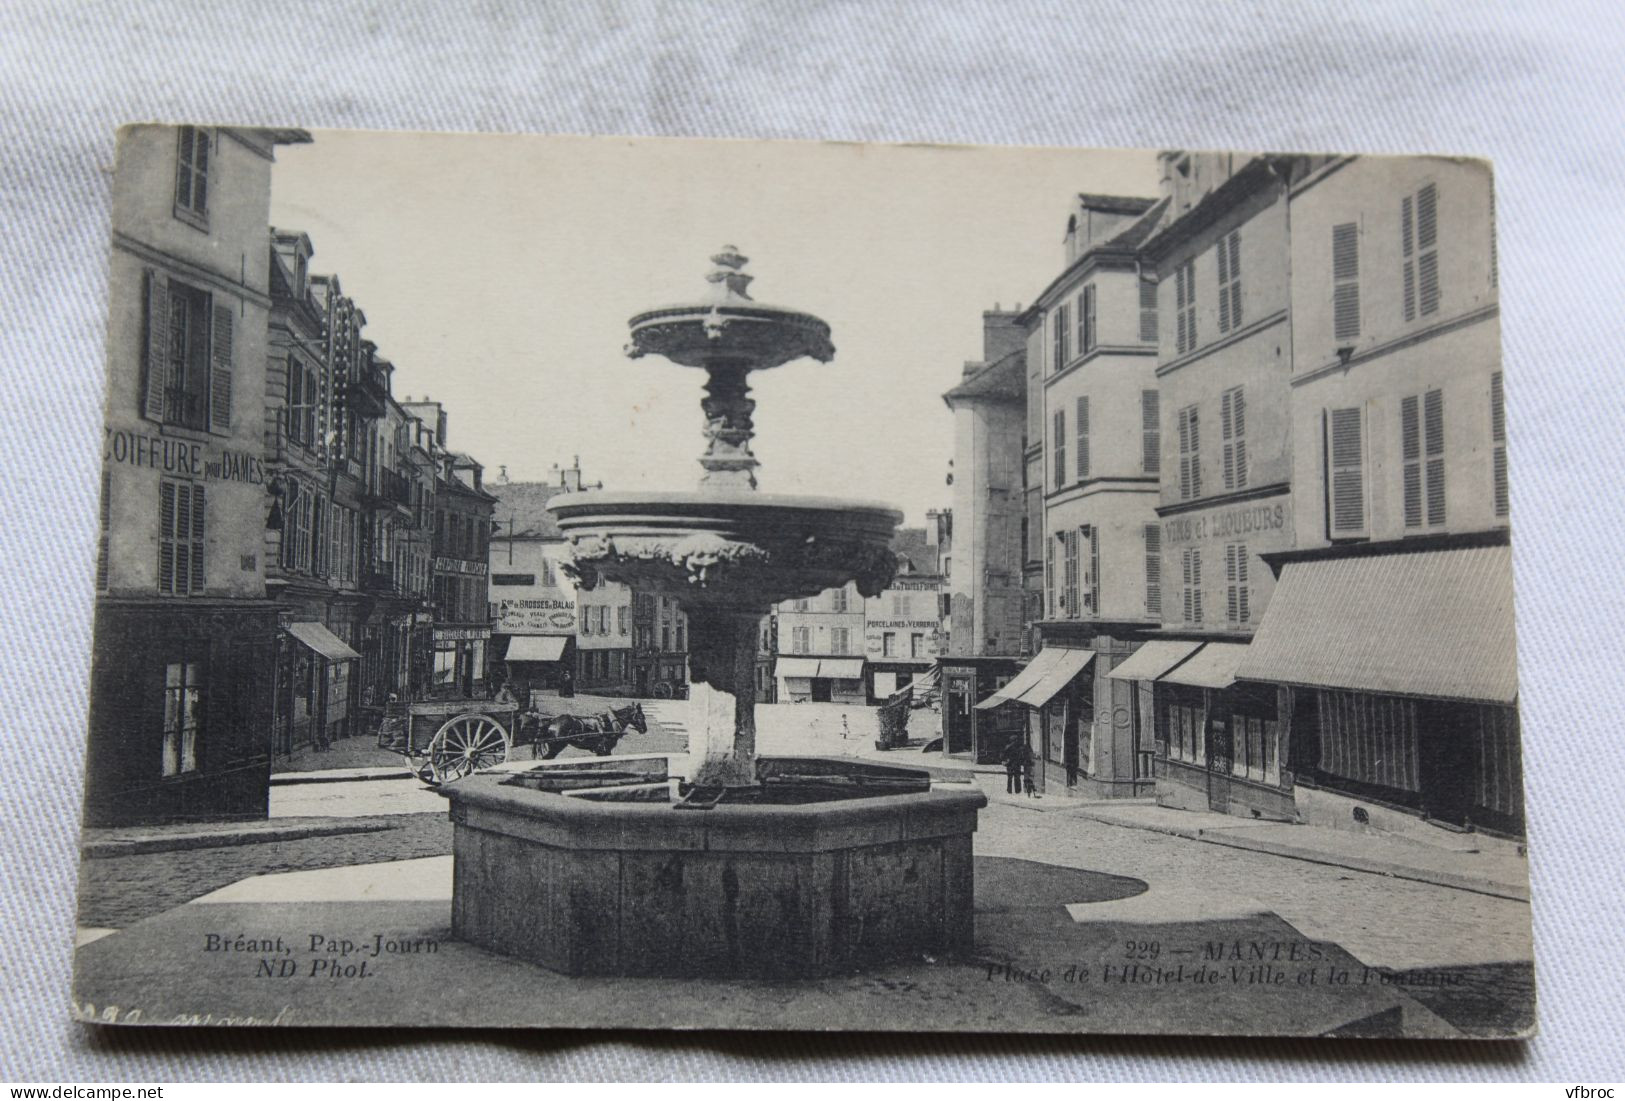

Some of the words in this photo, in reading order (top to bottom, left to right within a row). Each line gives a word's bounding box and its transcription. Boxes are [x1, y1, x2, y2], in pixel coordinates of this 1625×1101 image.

[222, 451, 264, 485] DAMES
[1212, 505, 1284, 537] LIQUEURS
[553, 600, 575, 609] BALAIS
[204, 934, 291, 955] Bréant,
[1125, 940, 1161, 960] 229
[1203, 942, 1330, 962] MANTES.
[256, 959, 296, 978] ND
[309, 959, 374, 978] Phot.
[986, 965, 1050, 984] Place
[1064, 965, 1090, 983] de
[1297, 966, 1318, 985] et
[1328, 966, 1349, 985] la
